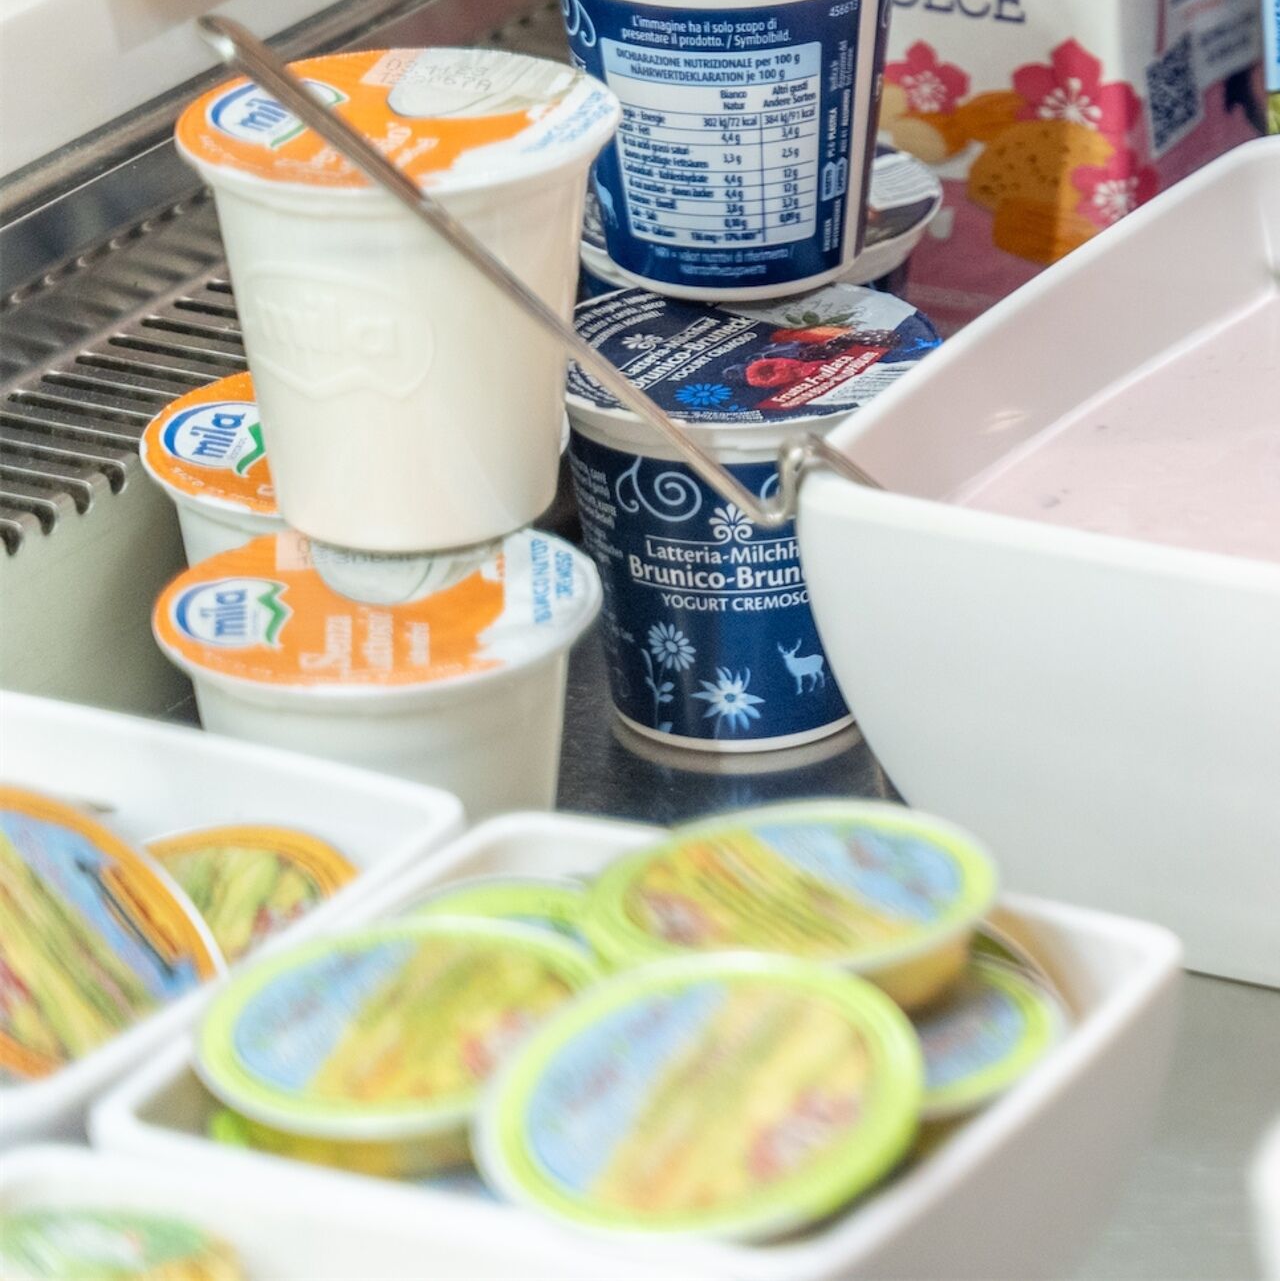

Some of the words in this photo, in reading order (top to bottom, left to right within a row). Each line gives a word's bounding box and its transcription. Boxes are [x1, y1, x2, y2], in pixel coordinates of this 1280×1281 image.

[632, 15, 688, 34] L'immagine
[711, 20, 733, 33] solo
[735, 20, 765, 36] scopo
[621, 27, 670, 45] presentare
[679, 31, 725, 48] prodotto.
[734, 28, 792, 48] Symbolbild.
[616, 47, 681, 68] DICHIARAZIONE
[683, 57, 753, 70] NUTRIZIONALE
[755, 57, 772, 70] per
[774, 53, 793, 65] 100
[630, 63, 744, 83] NÄHRWERTDEKLARATION
[759, 68, 777, 80] 100
[720, 89, 748, 100] Bianco
[772, 83, 789, 97] Altri
[789, 79, 809, 95] gusti
[723, 101, 746, 111] Natur
[762, 95, 791, 110] Andere
[792, 90, 817, 105] Sorten
[667, 352, 712, 382] YOGURT
[709, 331, 758, 359] CREMOSO
[189, 412, 246, 459] mila
[645, 538, 800, 565] Latteria-Milchh
[628, 554, 804, 591] Brunico-Brun
[213, 589, 247, 637] mila
[660, 591, 730, 613] YOGURT
[731, 590, 811, 613] CREMOSO
